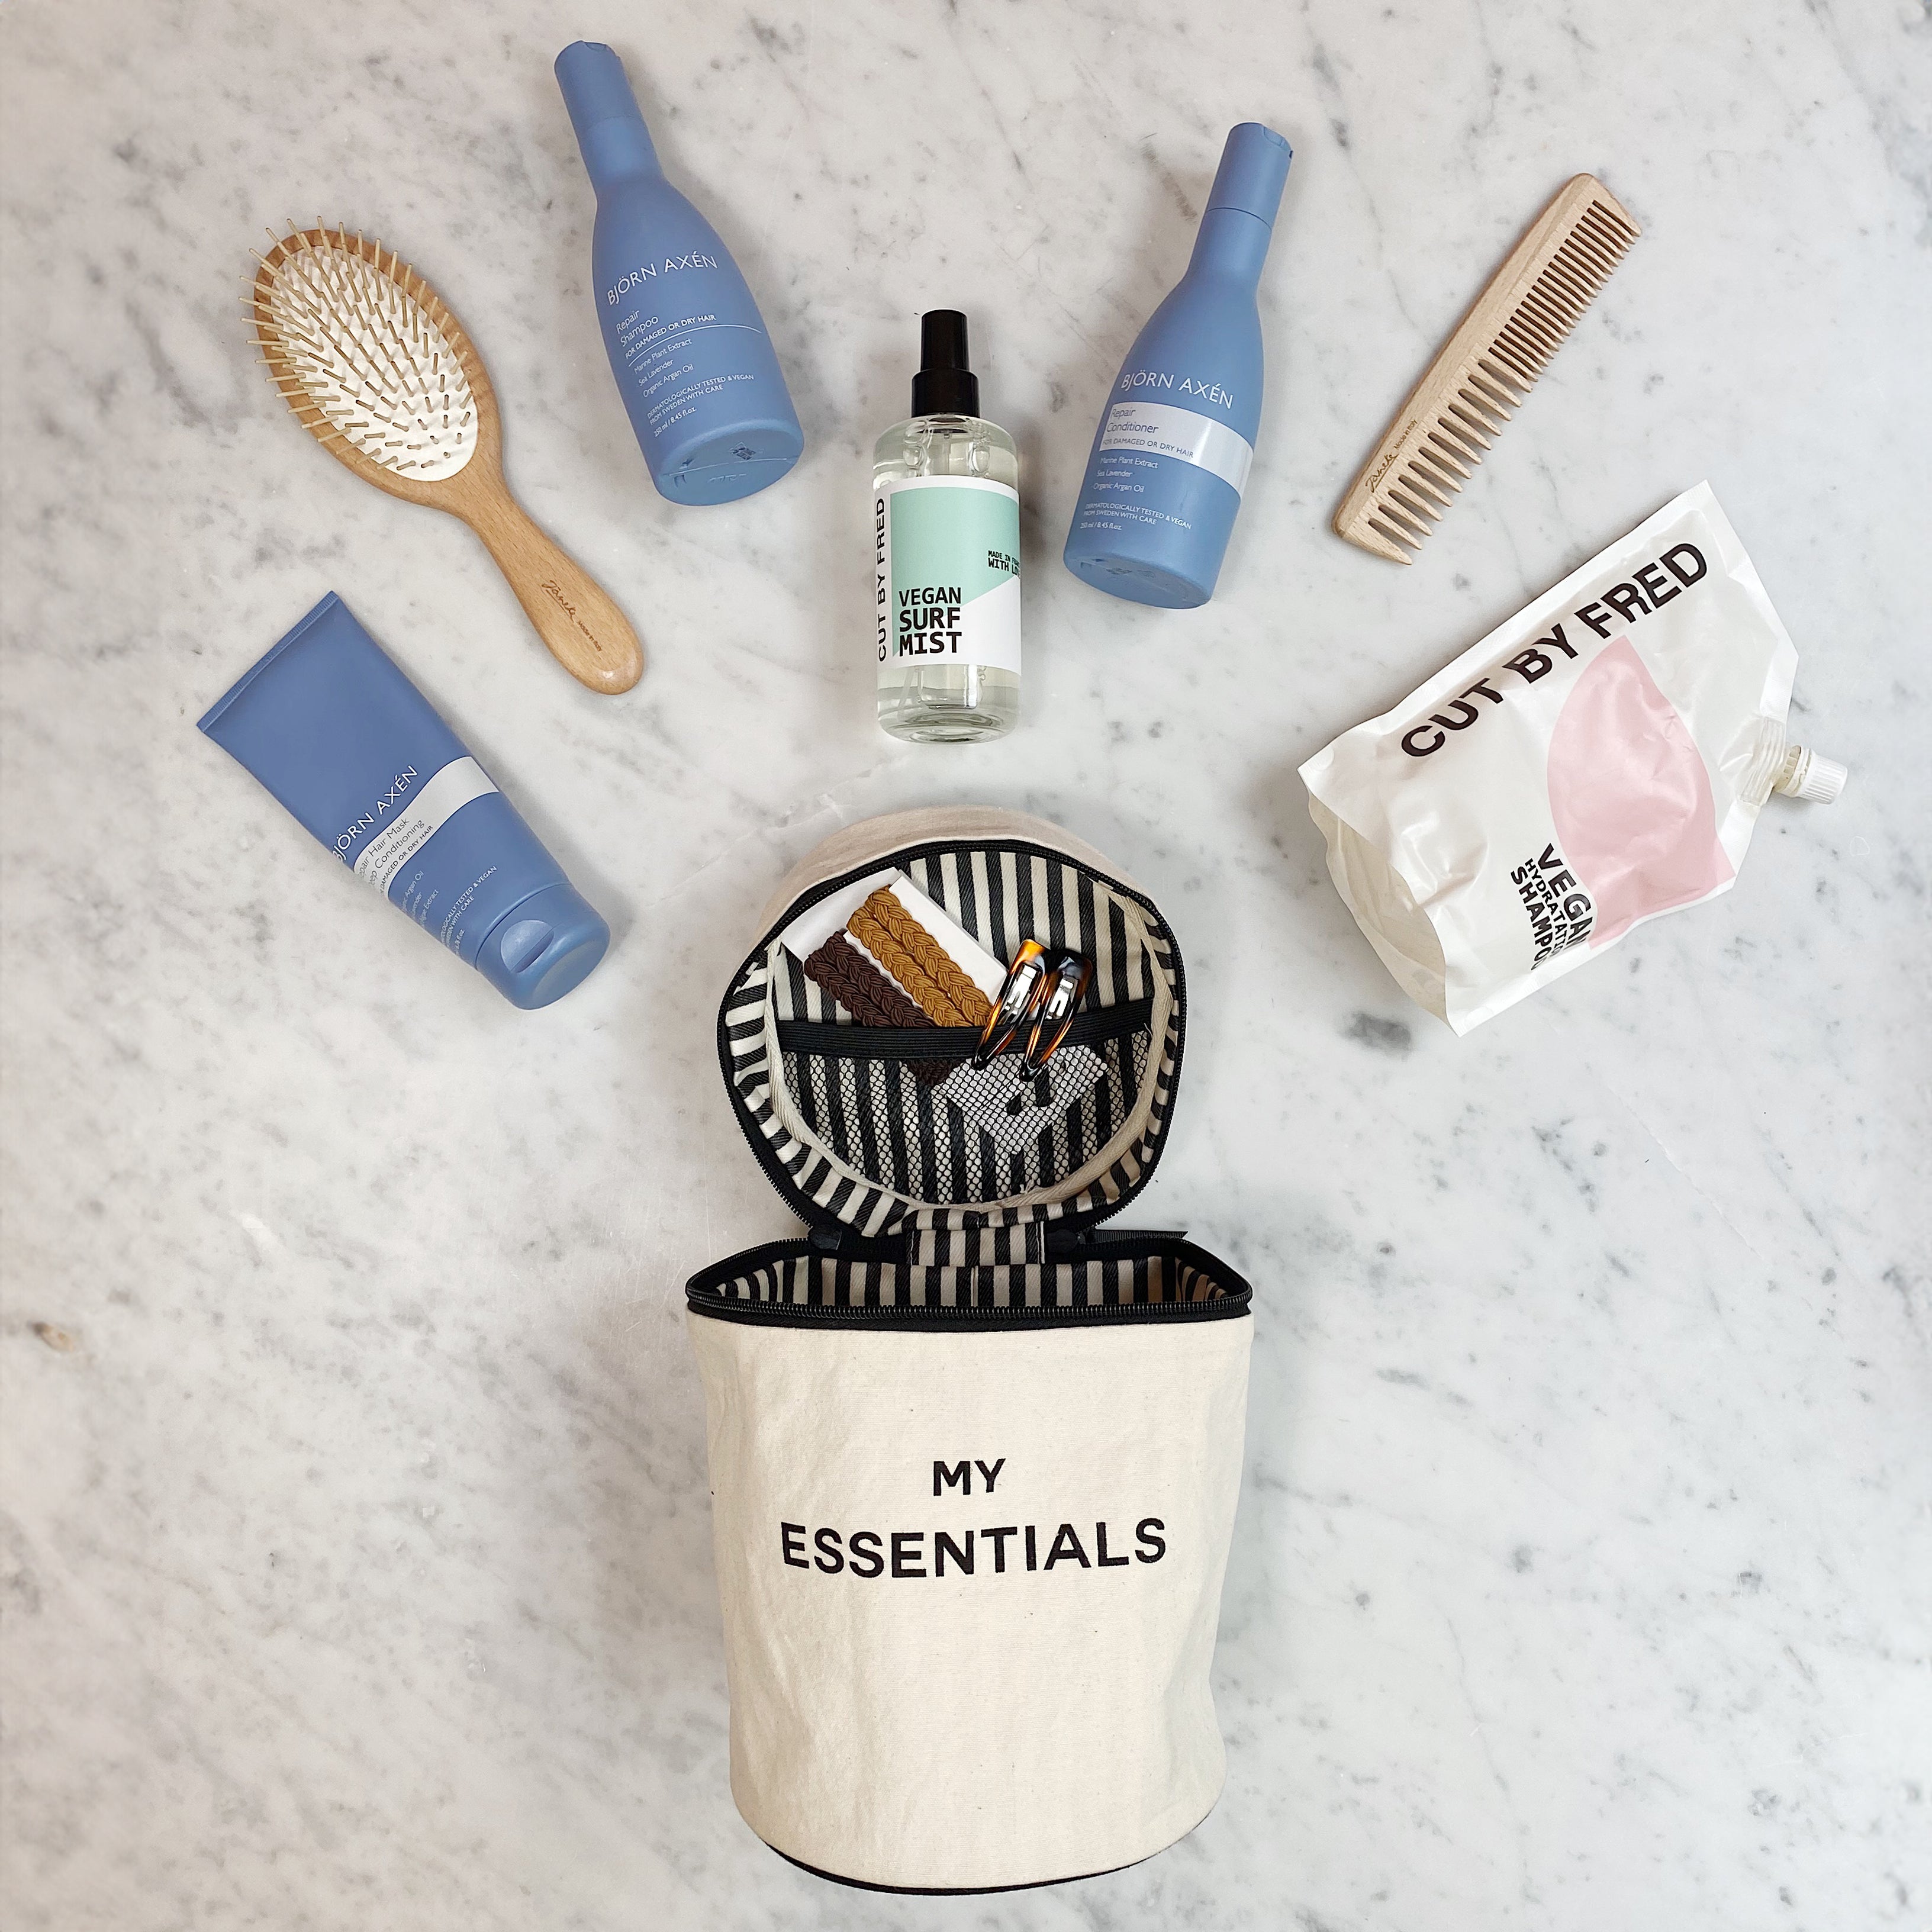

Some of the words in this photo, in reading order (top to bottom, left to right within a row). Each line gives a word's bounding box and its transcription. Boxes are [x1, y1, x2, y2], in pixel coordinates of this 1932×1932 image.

[607, 263, 657, 305] BJÖRN
[664, 250, 718, 272] AXÉN
[616, 310, 639, 334] Repair
[620, 316, 658, 347] Shampoo
[626, 347, 636, 359] FOR
[635, 327, 666, 350] DAMAGED
[681, 317, 695, 326] DRY
[697, 314, 716, 323] HAIR
[634, 359, 651, 374] Marine
[651, 349, 668, 360] Plant
[667, 338, 693, 352] Extract
[638, 377, 648, 387] Sea
[648, 359, 673, 378] Lavender
[643, 381, 664, 397] Organic
[663, 370, 682, 384] Argan
[682, 363, 694, 373] Oil
[1121, 369, 1174, 392] BJÖRN
[1178, 378, 1234, 409] AXÉN
[647, 382, 701, 418] DERMATOLOGICALLY
[702, 376, 726, 387] TESTED
[650, 414, 662, 426] FROM
[662, 397, 686, 415] SWEDEN
[685, 390, 704, 401] WITH
[705, 384, 723, 394] CARE
[1111, 407, 1136, 419] Repair
[1106, 421, 1159, 433] Conditioner
[1134, 458, 1158, 468] Extract
[1160, 443, 1175, 451] DRY
[1176, 447, 1194, 458] HAIR
[1113, 482, 1132, 492] Argan
[1134, 484, 1145, 493] Oil
[876, 498, 885, 565] FRED
[1086, 503, 1141, 513] DERMATOLOGICALLY
[1141, 508, 1164, 519] TESTED
[1171, 517, 1192, 530] VEGAN
[1139, 516, 1157, 525] CARE
[988, 550, 1002, 559] MADE
[988, 558, 1009, 571] WITH
[877, 574, 886, 605] BY
[899, 587, 961, 607] VEGAN
[899, 607, 961, 632] SURF
[878, 614, 887, 662] CUT
[899, 632, 962, 657] MIST
[1400, 677, 1503, 757] CUT
[1501, 623, 1579, 684] BY
[1573, 543, 1707, 639] FRED
[332, 812, 375, 862] BJÖRN
[376, 765, 418, 815] AXÉN
[359, 856, 369, 878] epair
[368, 838, 386, 857] Hair
[387, 817, 410, 839] Mask
[368, 870, 378, 886] eep
[375, 820, 425, 869] Conditioning
[380, 861, 398, 890] DAMAGED
[398, 851, 408, 861] OR
[407, 839, 420, 852] DRY
[419, 825, 433, 840] HAIR
[415, 870, 424, 881] Oil
[456, 887, 474, 906] TESTED
[476, 866, 497, 883] VEGAN
[424, 889, 439, 909] Extract
[451, 910, 462, 926] WITH
[461, 895, 475, 911] CARE
[1538, 843, 1593, 950] VEGAN
[1511, 866, 1553, 971] SHAMPOO
[932, 1458, 1006, 1496] MY
[781, 1518, 1167, 1579] ESSENTIALS
